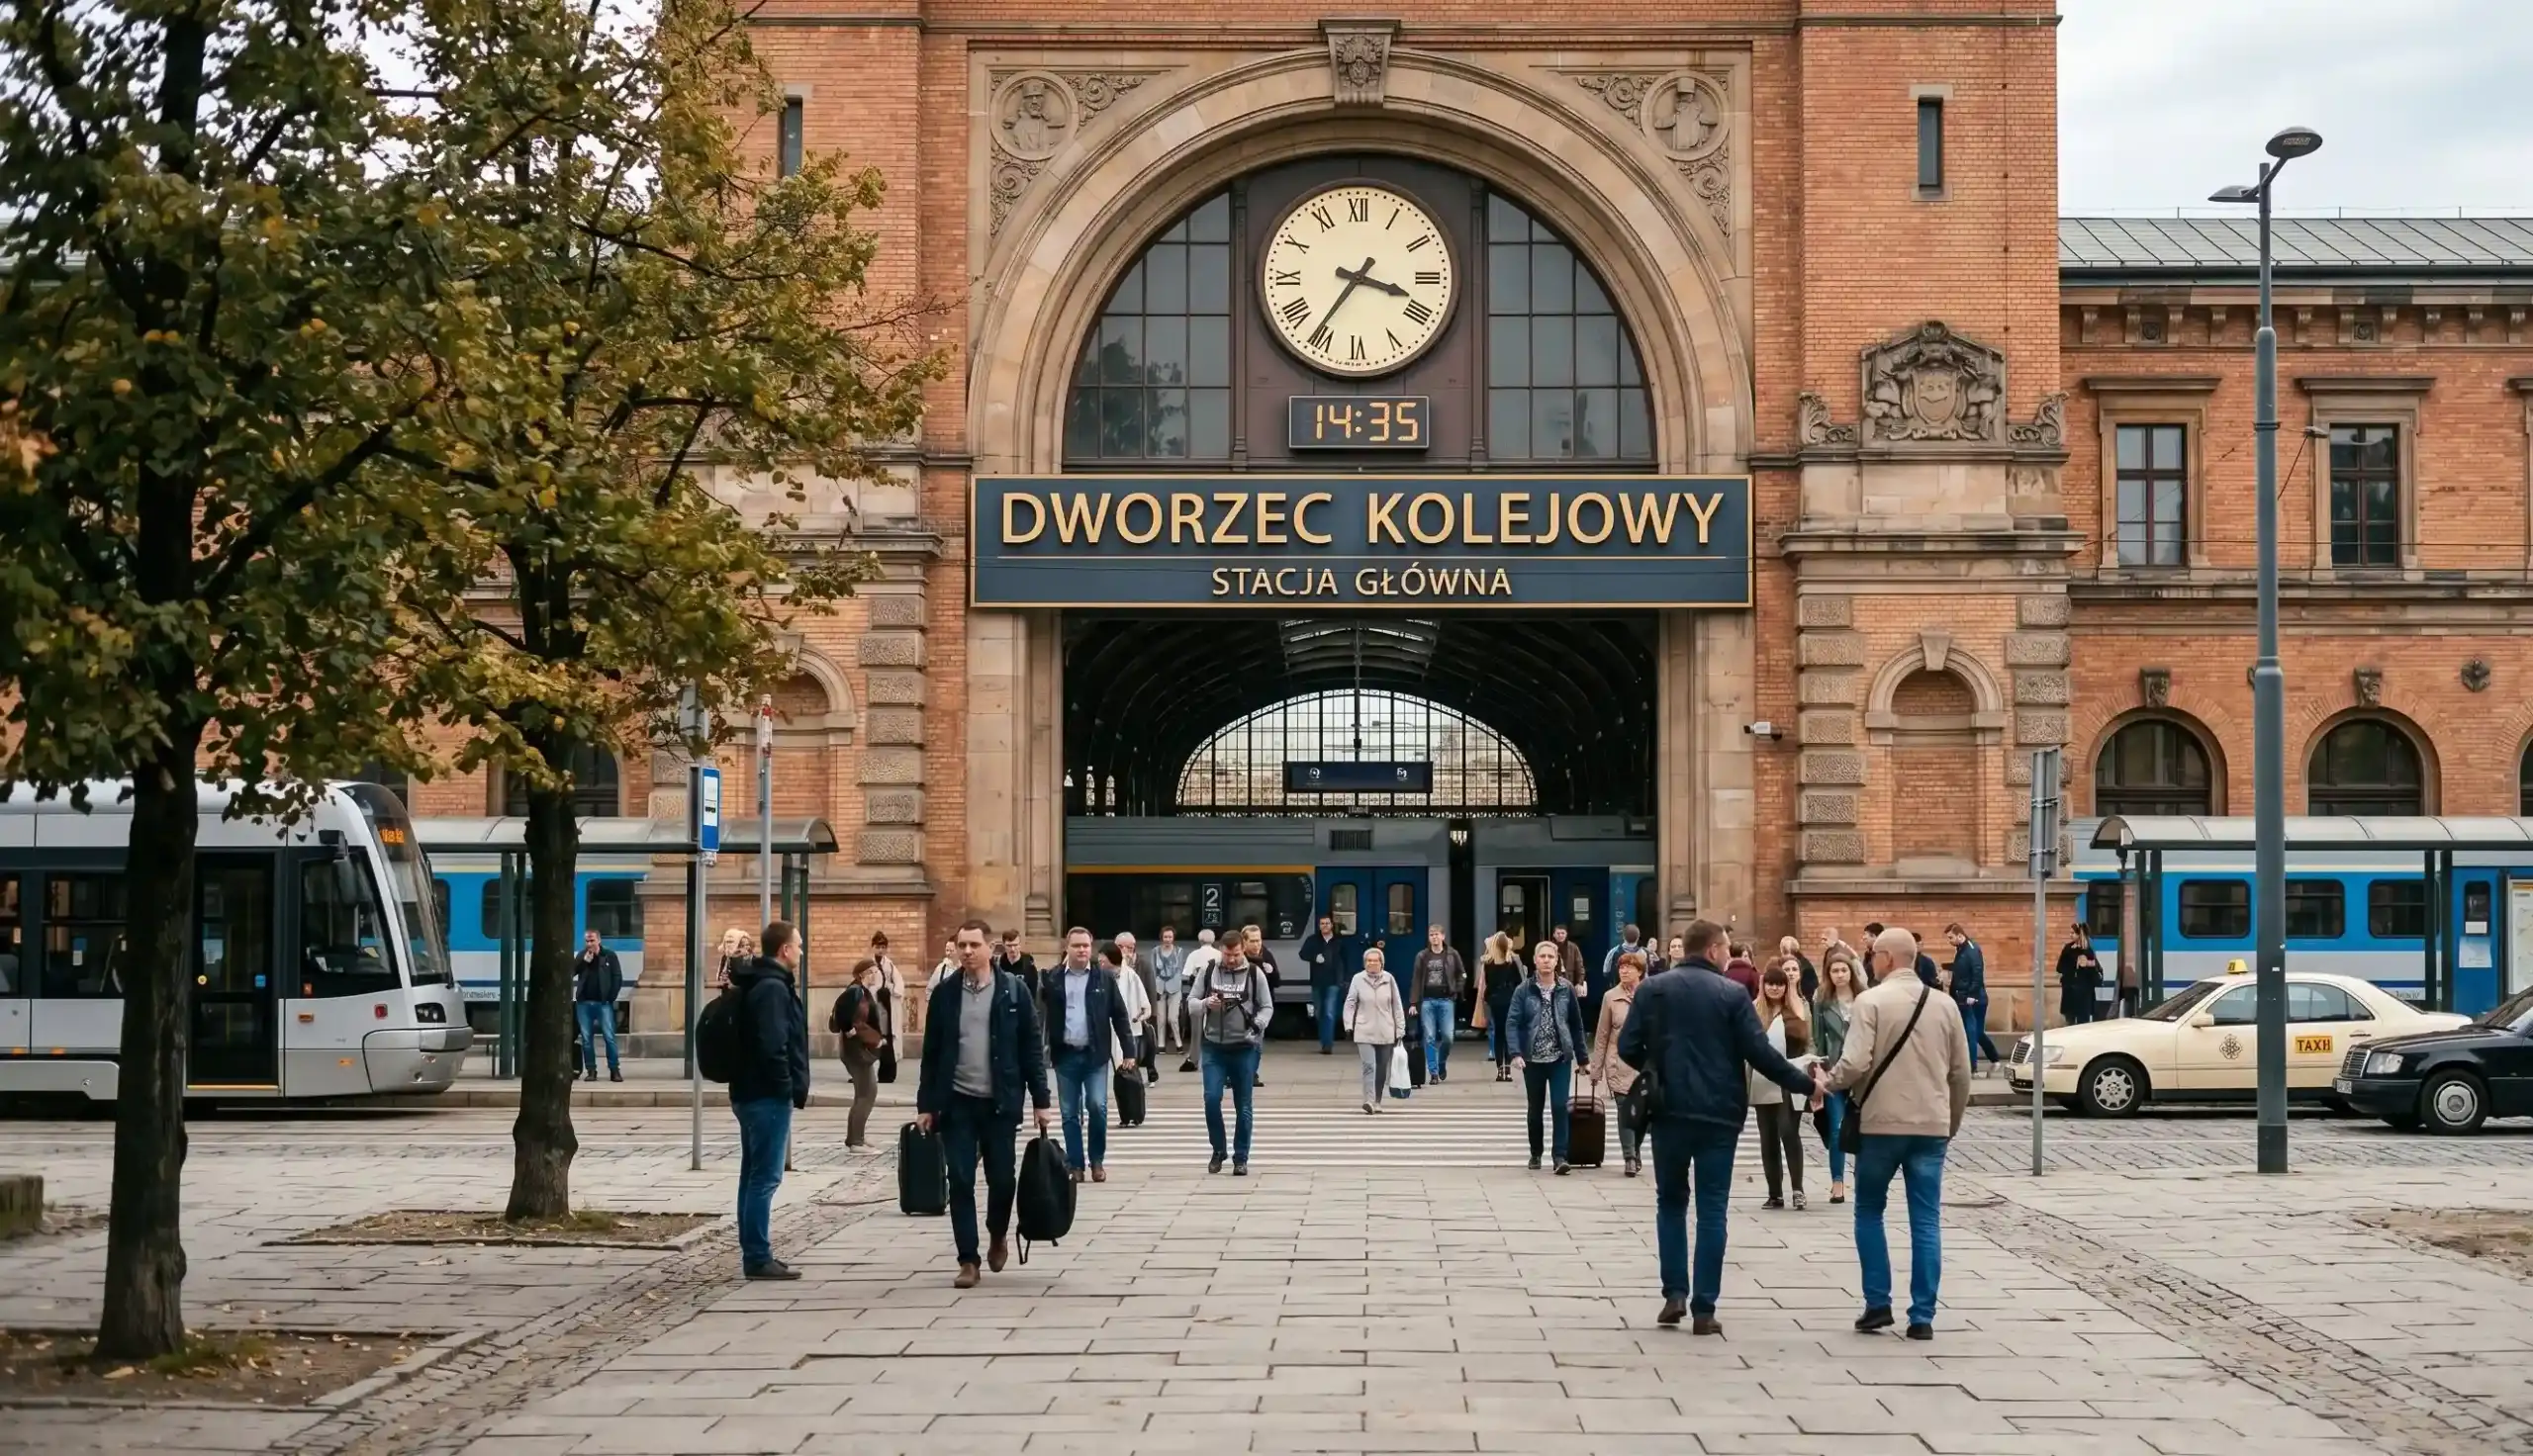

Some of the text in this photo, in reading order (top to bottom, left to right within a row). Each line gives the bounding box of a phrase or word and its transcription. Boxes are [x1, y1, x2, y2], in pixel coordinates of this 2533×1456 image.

[1310, 205, 1336, 233] XI
[1347, 197, 1369, 223] XII
[1384, 208, 1401, 230] I
[1284, 233, 1310, 255] X
[1405, 233, 1431, 253] II
[1275, 270, 1301, 287] IX
[1414, 271, 1441, 285] III
[1281, 296, 1312, 330] VIII
[1402, 299, 1433, 326] IIII
[1350, 334, 1366, 360] VI
[1385, 327, 1403, 352] V
[1315, 402, 1419, 442] 14:35
[1001, 492, 1725, 544] DWORZEC KOLEJOWY
[1212, 561, 1512, 595] STACJA GŁÓWNA
[1205, 887, 1219, 907] 2
